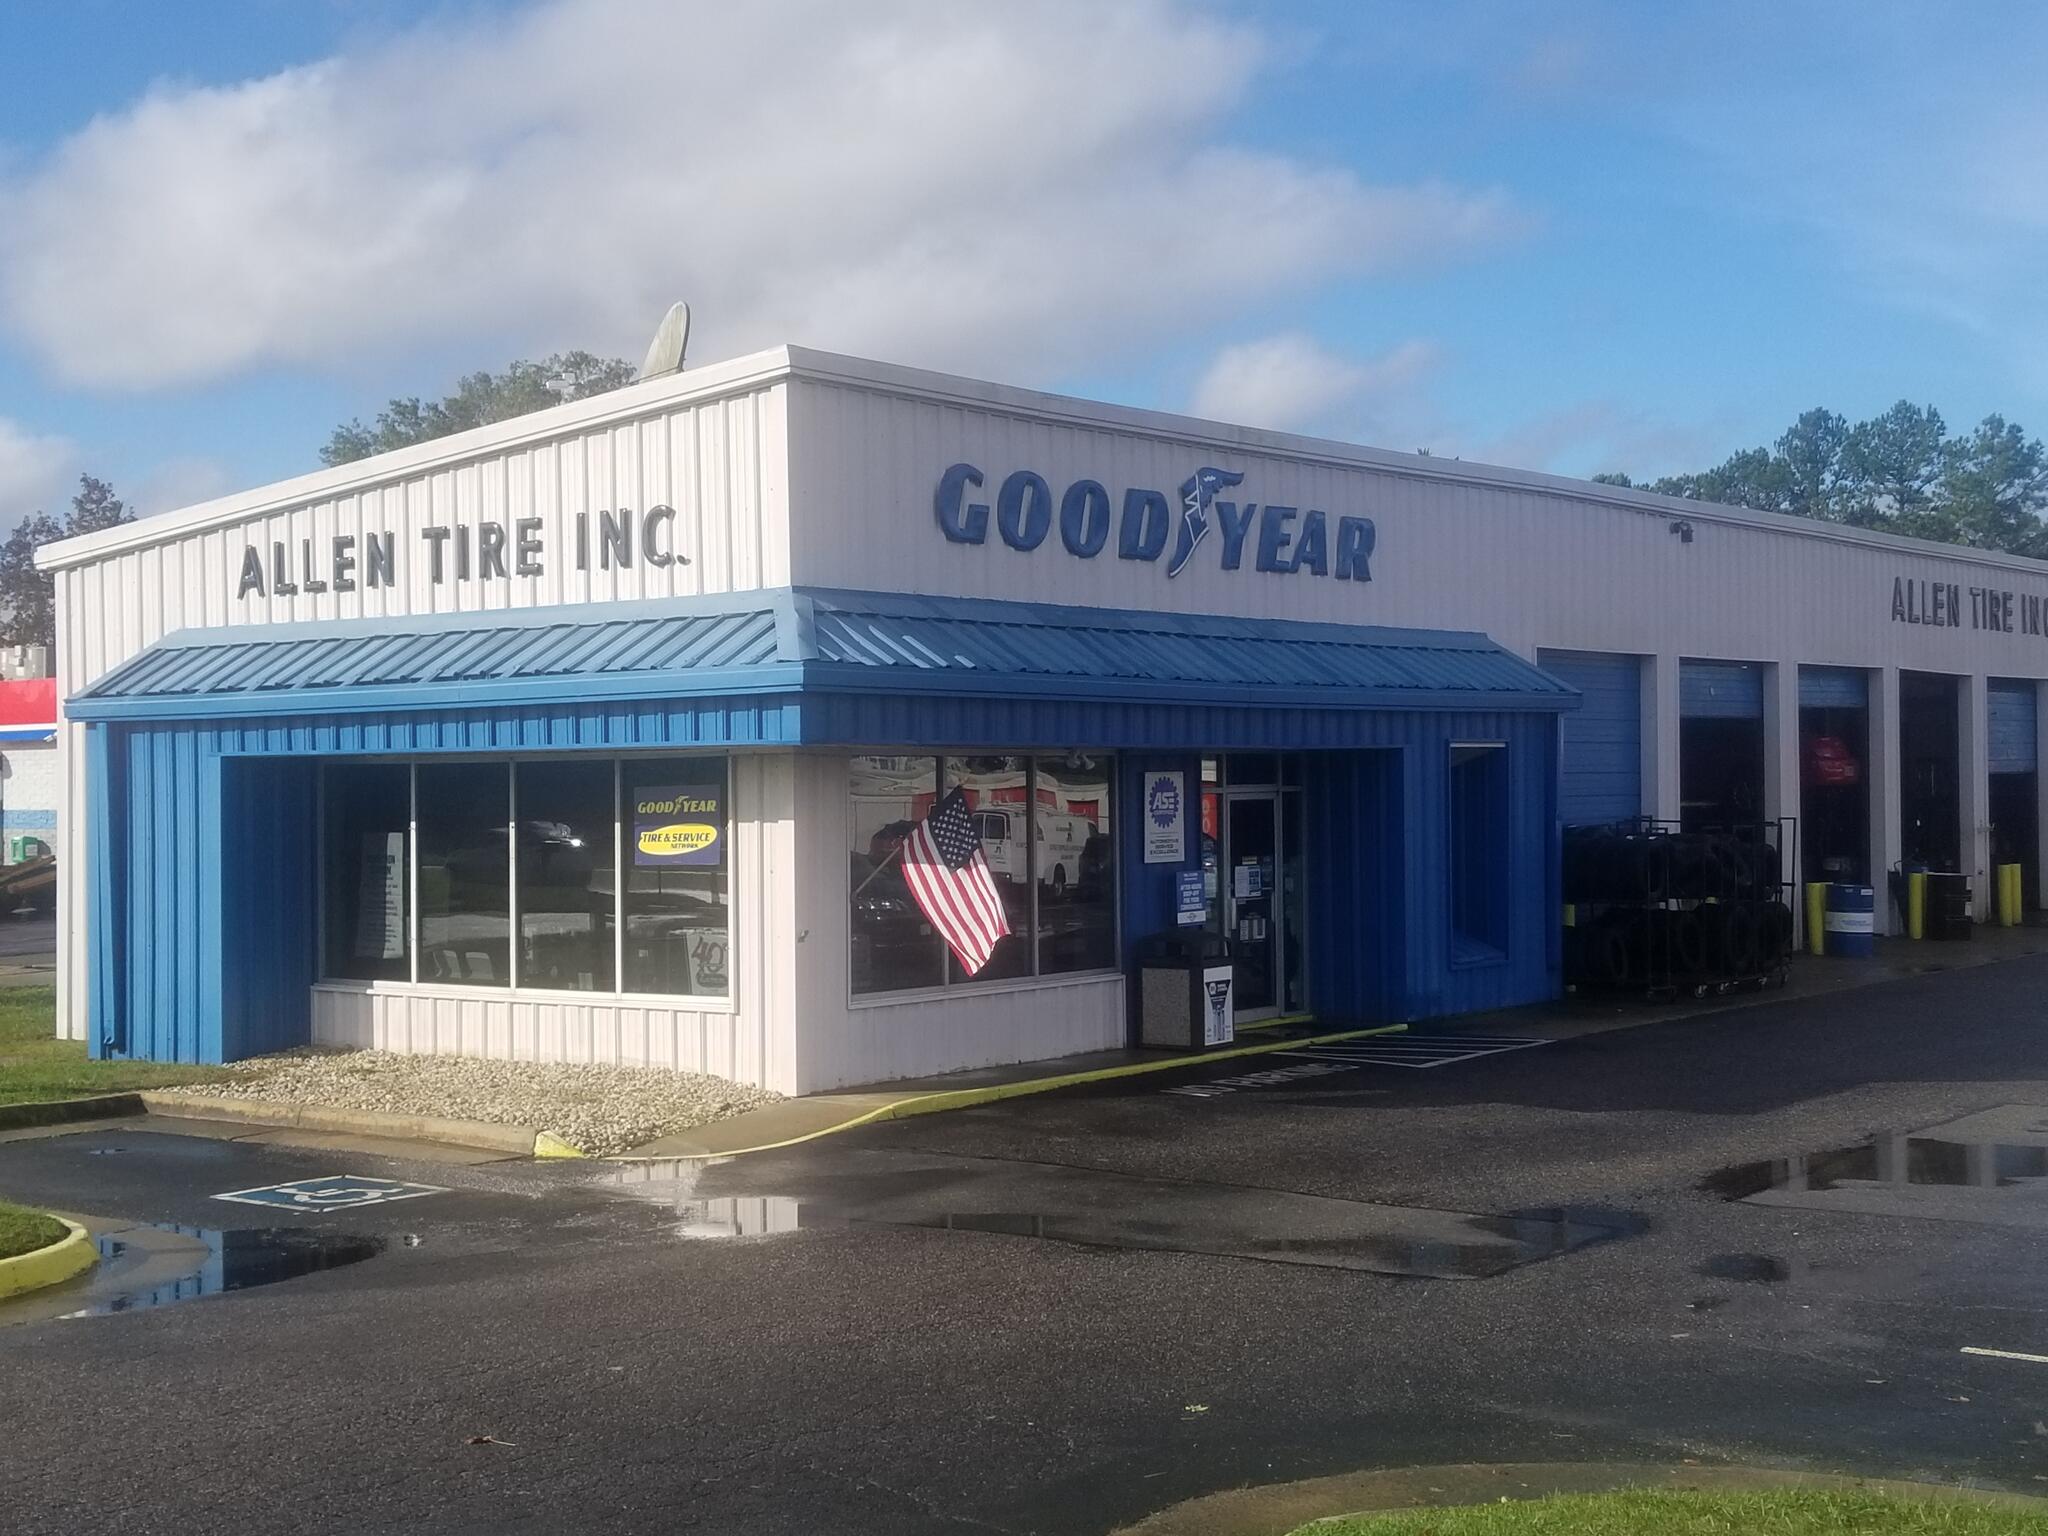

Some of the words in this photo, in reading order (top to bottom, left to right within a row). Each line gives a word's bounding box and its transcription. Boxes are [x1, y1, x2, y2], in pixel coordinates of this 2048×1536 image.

[936, 462, 1377, 582] GOODYEAR
[236, 530, 395, 600] ALLEN
[422, 516, 544, 585] TIRE
[576, 504, 691, 572] INC.
[1891, 576, 1961, 628] ALLEN
[1968, 586, 2014, 633] TIRE
[637, 797, 718, 815] GOODYEAR
[1152, 791, 1175, 810] ASE
[642, 833, 664, 843] TIRE
[664, 833, 672, 843] &
[672, 832, 711, 842] SERVICE
